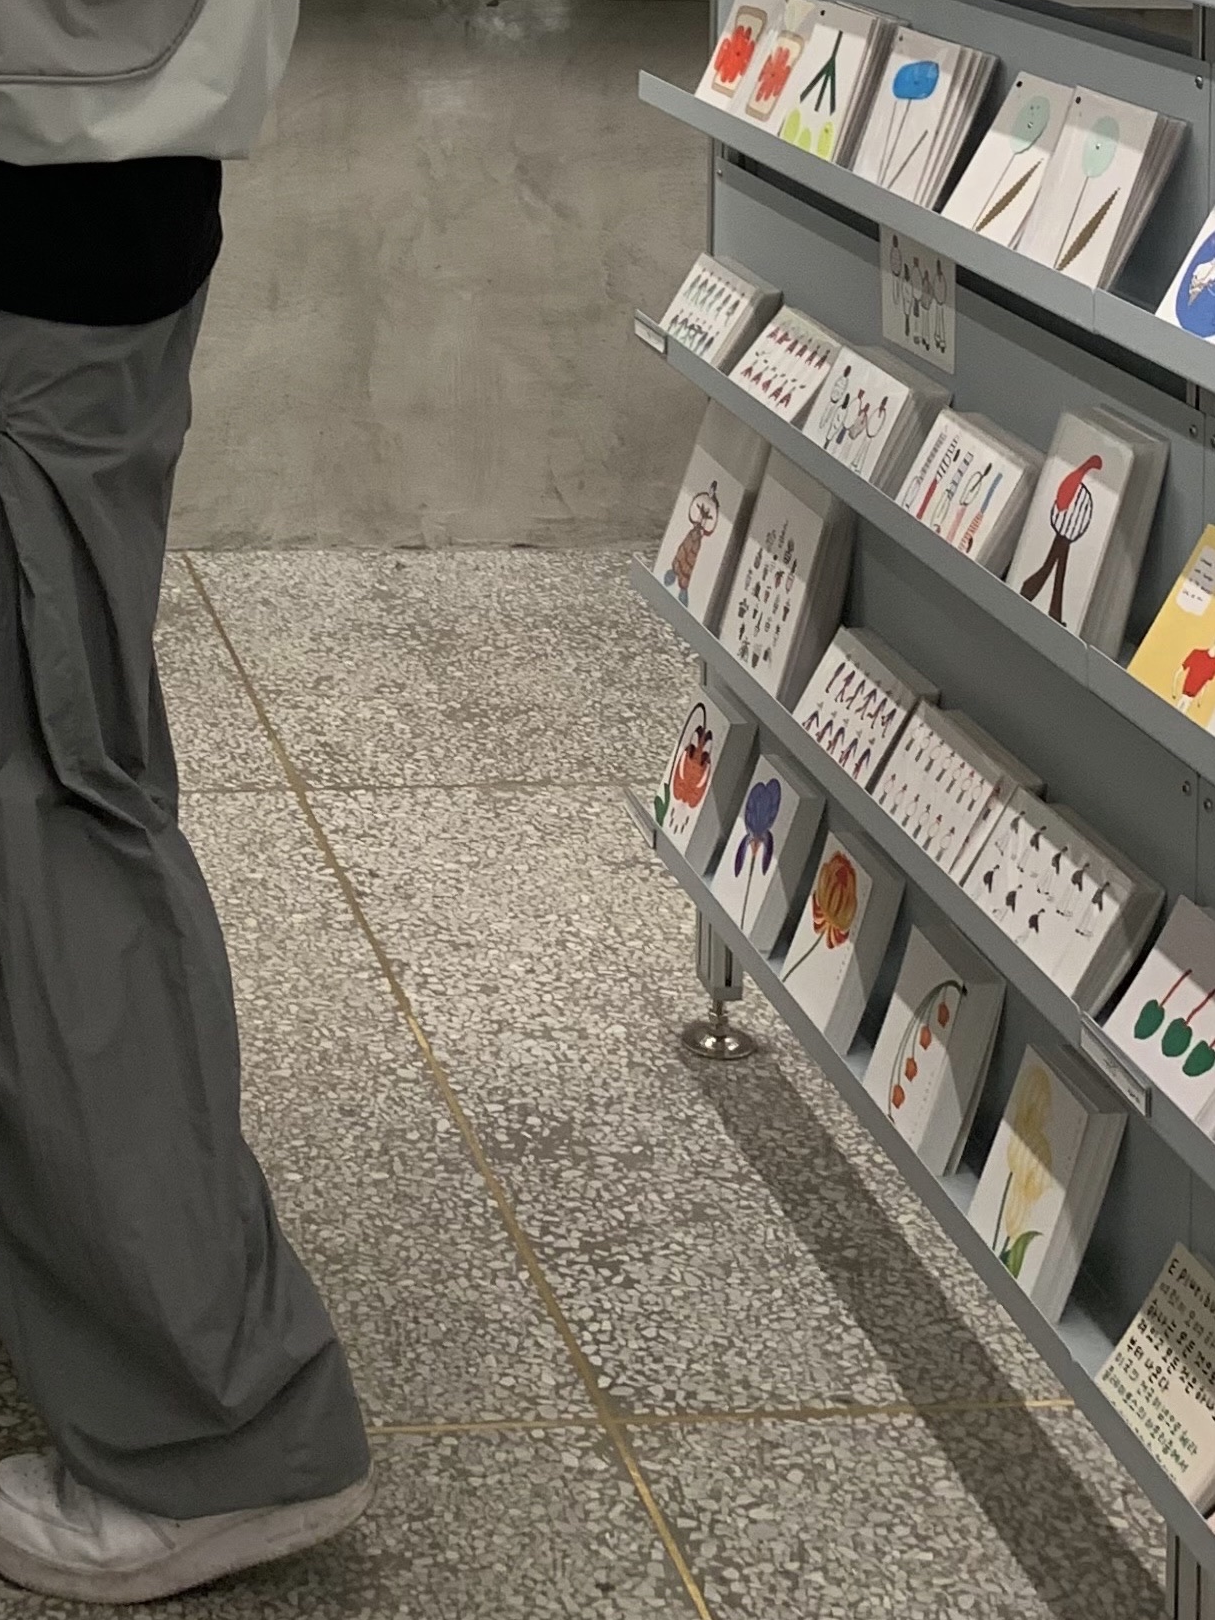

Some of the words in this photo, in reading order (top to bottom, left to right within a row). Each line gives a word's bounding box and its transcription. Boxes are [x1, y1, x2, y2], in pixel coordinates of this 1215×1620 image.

[1143, 1299, 1177, 1340] 하나는
[1172, 1332, 1195, 1360] 모든
[1127, 1337, 1144, 1360] 부터
[1144, 1359, 1169, 1392] 나온다
[1162, 1348, 1180, 1374] 모든
[1179, 1366, 1197, 1394] 것은
[1195, 1386, 1215, 1421] 하나
